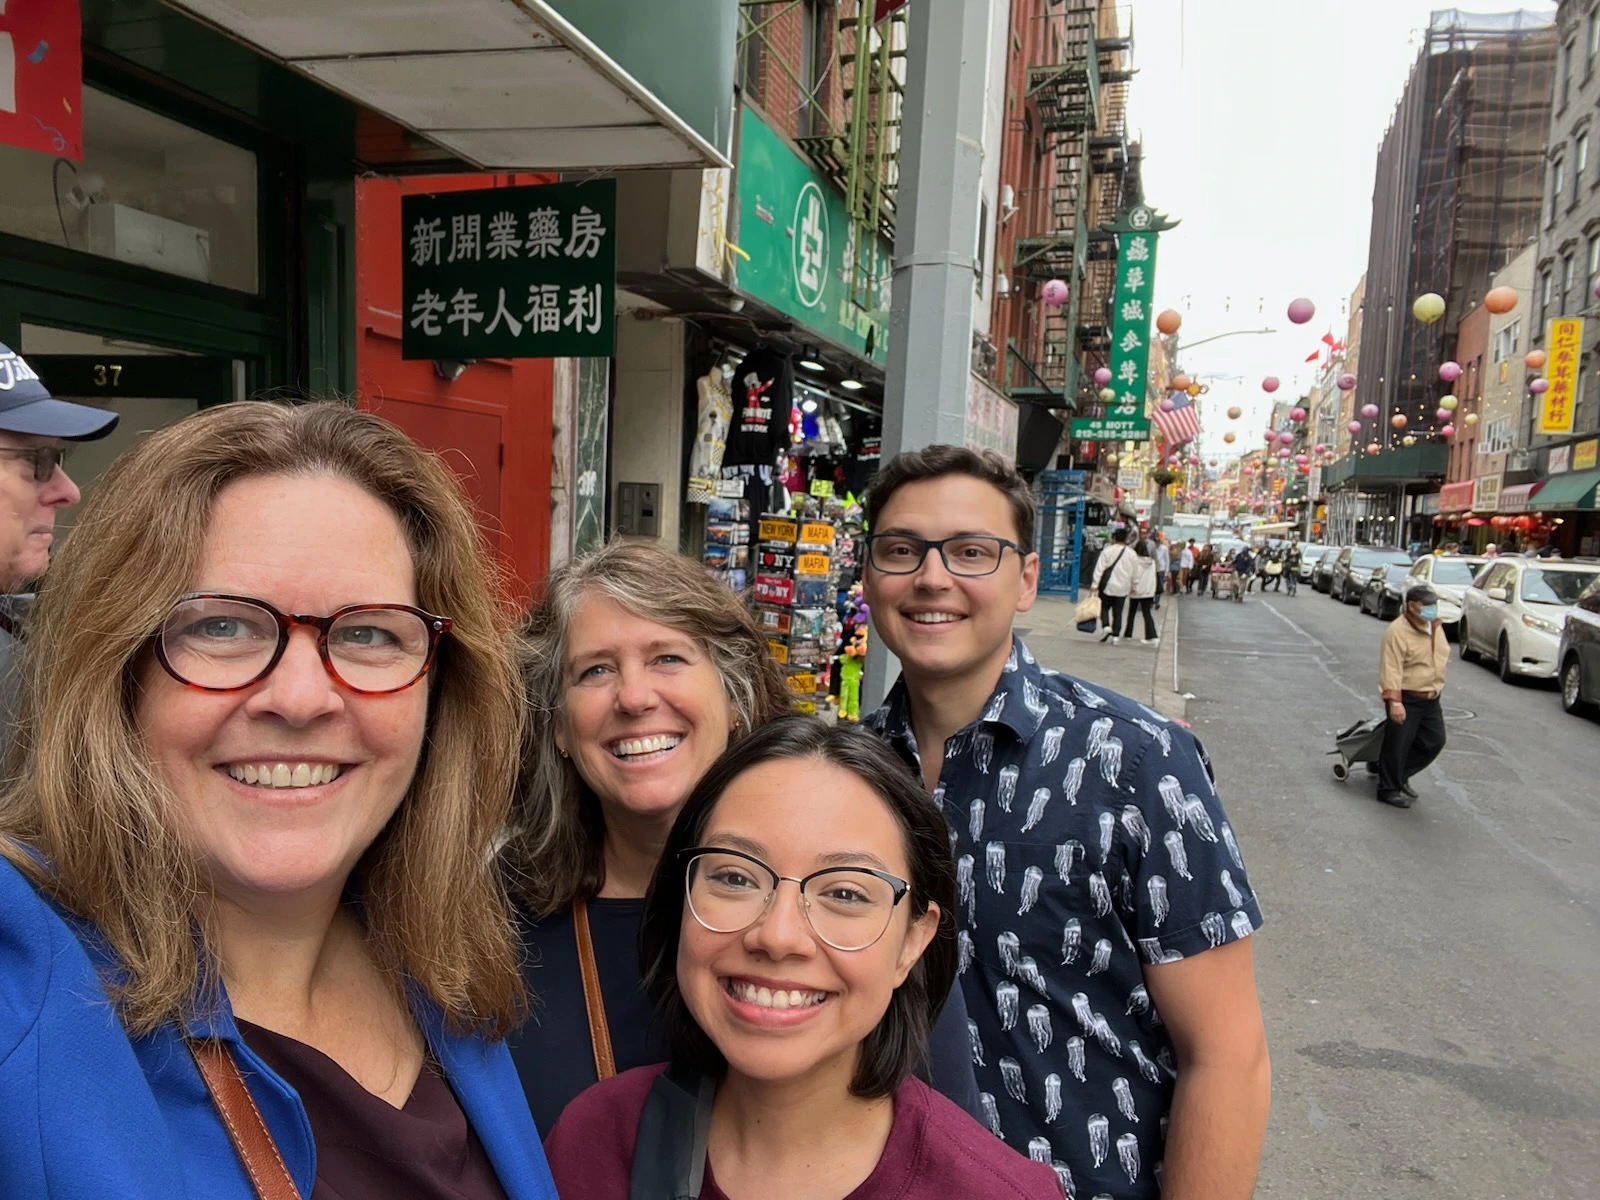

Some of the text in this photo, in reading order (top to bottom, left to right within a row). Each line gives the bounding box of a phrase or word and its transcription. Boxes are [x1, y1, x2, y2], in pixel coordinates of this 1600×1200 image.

[409, 205, 607, 267] 新開業藥房
[409, 282, 603, 338] 老年人福利
[93, 364, 122, 387] 37
[1105, 421, 1135, 429] MOTT
[762, 523, 795, 537] NEW YORK
[808, 527, 829, 539] MAFIA
[759, 553, 794, 568] I NY
[804, 557, 825, 569] MAFIA
